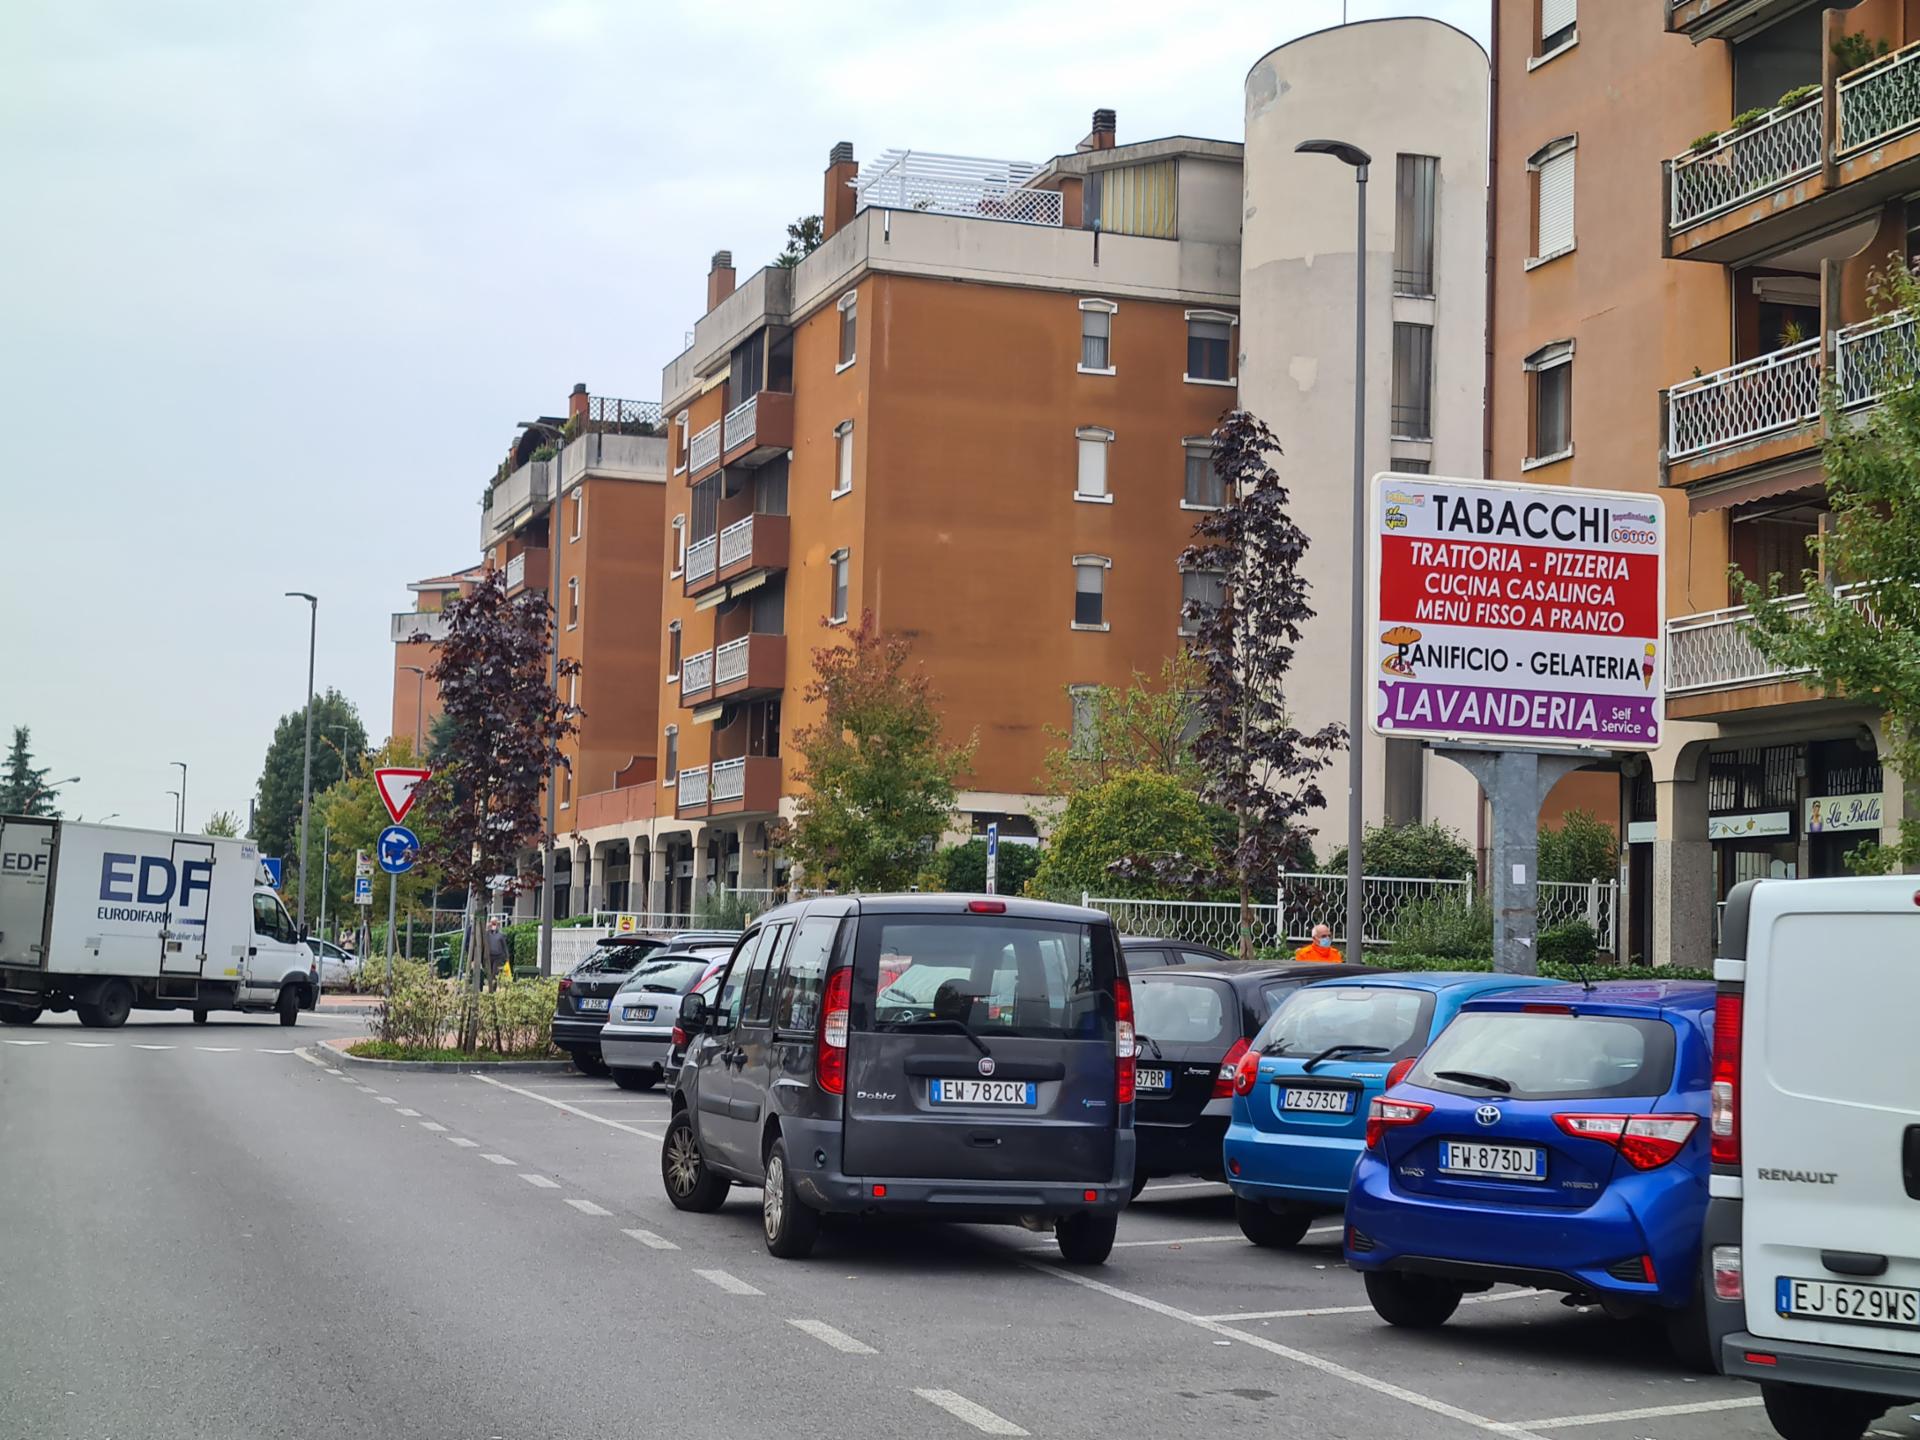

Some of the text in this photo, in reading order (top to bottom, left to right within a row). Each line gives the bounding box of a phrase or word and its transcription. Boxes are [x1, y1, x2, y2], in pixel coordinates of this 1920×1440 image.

[1432, 494, 1610, 543] TABACCHI
[1410, 541, 1523, 573] TRATTORIA
[1544, 552, 1630, 581] PIZZERIA
[1424, 571, 1616, 606] CUCINA CASALINGA
[1415, 596, 1625, 633] MENÙ FISSO A PRANZO
[1398, 643, 1509, 673] PANIFICIO
[1530, 651, 1641, 681] GELATERIA
[1395, 686, 1598, 732] LAVANDERIA
[1601, 719, 1642, 734] Service
[1611, 707, 1632, 720] Self
[1826, 798, 1880, 828] La Bella
[2, 852, 48, 871] EDF
[99, 852, 212, 907] EDF
[97, 906, 172, 924] EURODIFARM
[1758, 1167, 1838, 1185] RENAULT
